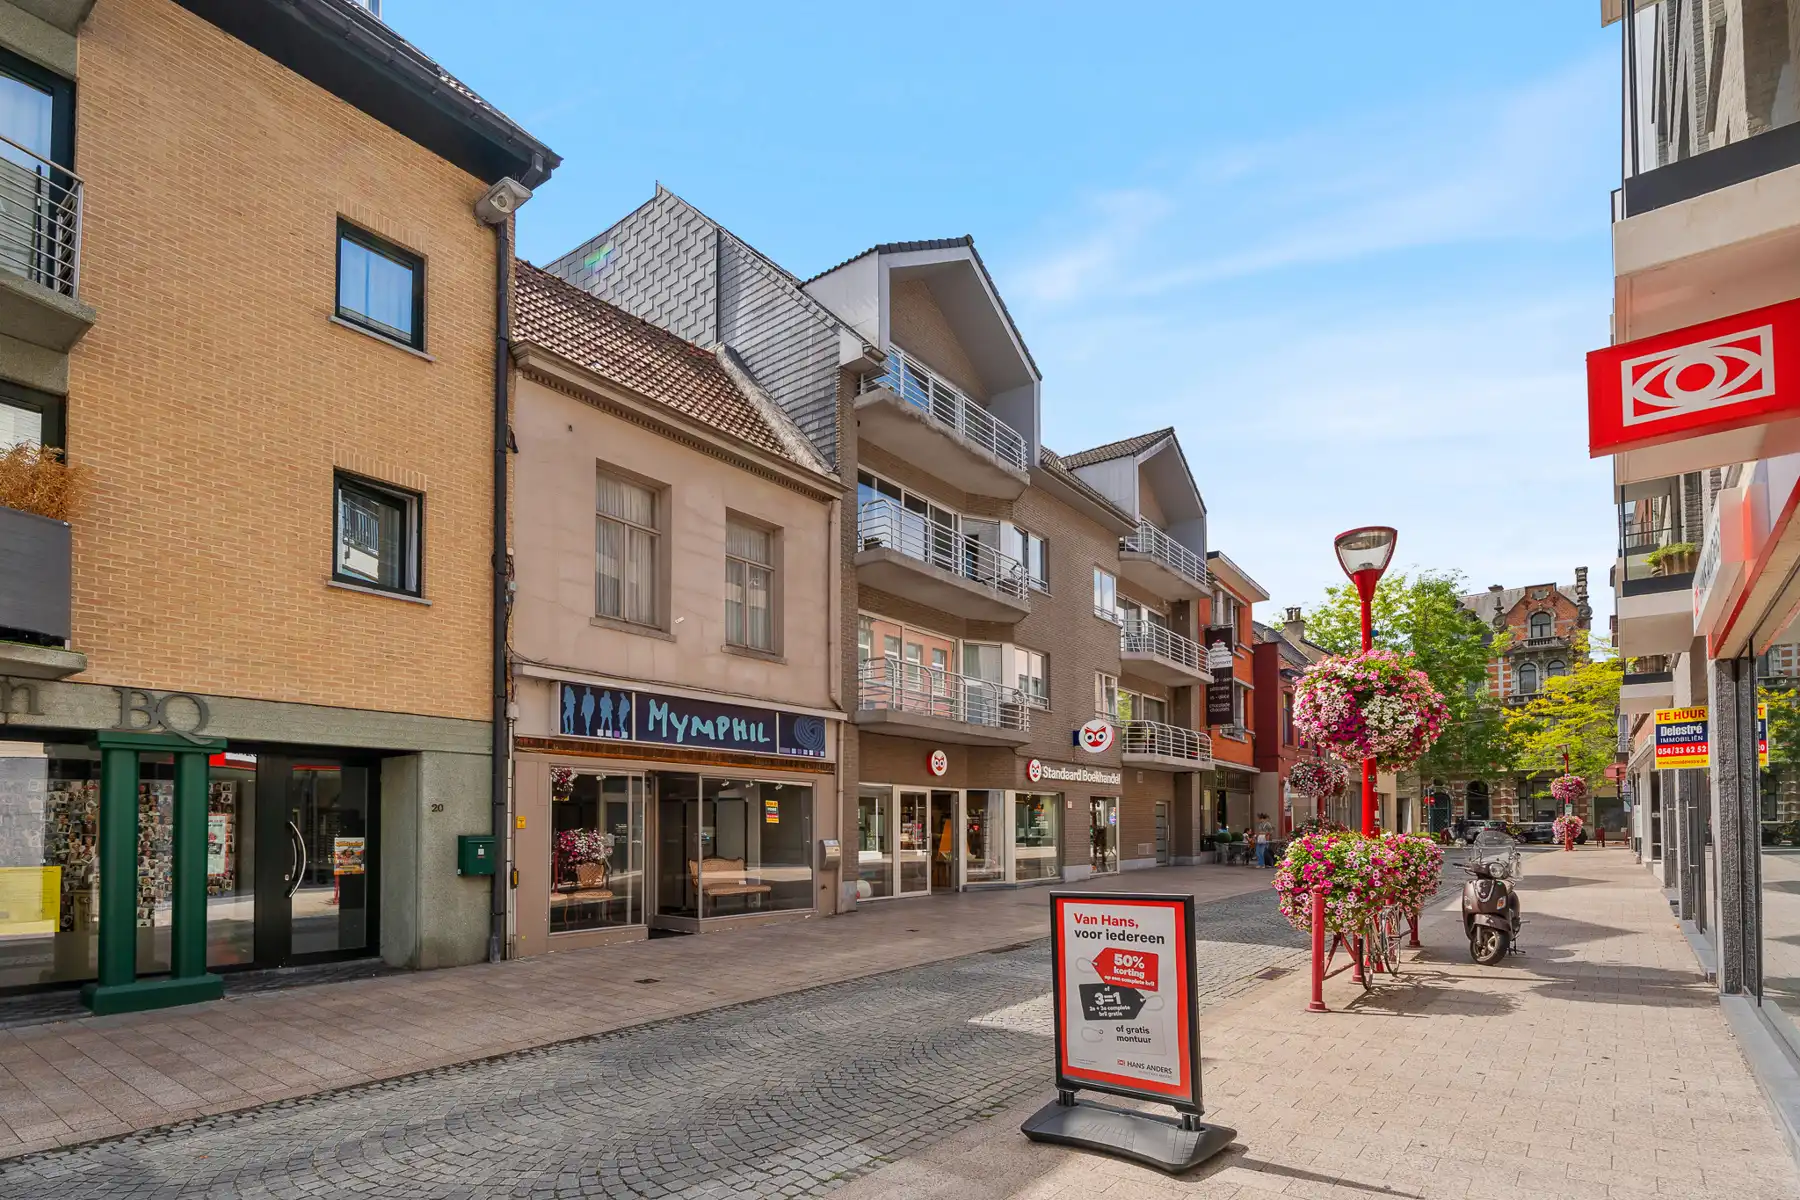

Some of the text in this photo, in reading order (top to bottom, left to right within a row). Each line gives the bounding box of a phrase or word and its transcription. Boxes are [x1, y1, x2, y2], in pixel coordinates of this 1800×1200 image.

[112, 687, 214, 745] BQ
[1657, 709, 1706, 721] TE HUUR
[1660, 723, 1703, 737] Delestré
[1660, 735, 1703, 743] IMMOBILIËN
[1657, 745, 1707, 755] 054/33 62 52
[1043, 766, 1120, 785] Standaard Boekhandel
[431, 803, 444, 813] 20
[1073, 912, 1139, 929] Van Hans,
[1074, 929, 1165, 945] voor iedereen
[1114, 953, 1145, 969] 50%
[1113, 966, 1145, 979] korting
[1121, 977, 1145, 985] complete
[1094, 991, 1122, 1006] 3=1
[1115, 1025, 1150, 1035] of gratis
[1116, 1035, 1151, 1044] montuur
[1126, 1060, 1145, 1070] HANS
[1146, 1064, 1172, 1075] ANDERS
